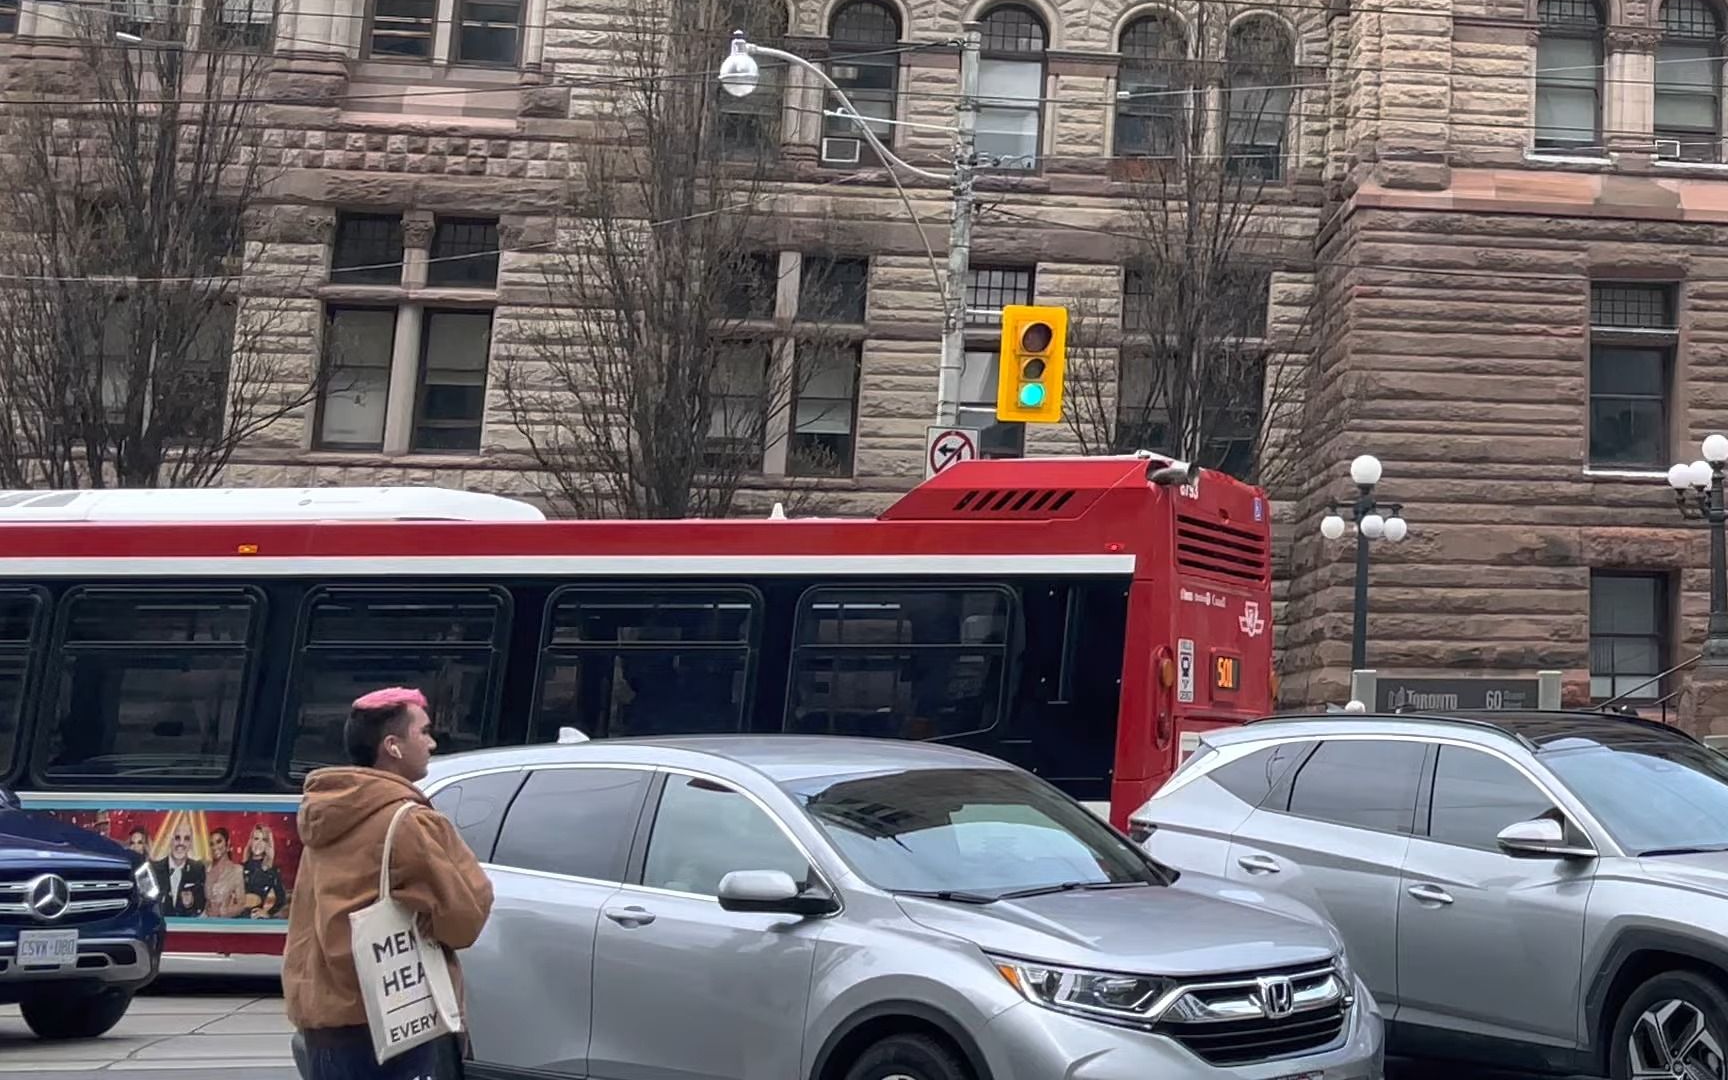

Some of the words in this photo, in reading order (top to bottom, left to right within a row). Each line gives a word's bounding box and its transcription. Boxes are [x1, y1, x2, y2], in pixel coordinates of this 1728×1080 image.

[1217, 657, 1233, 688] 501
[1486, 690, 1502, 710] 60
[390, 1011, 438, 1042] EVERY
